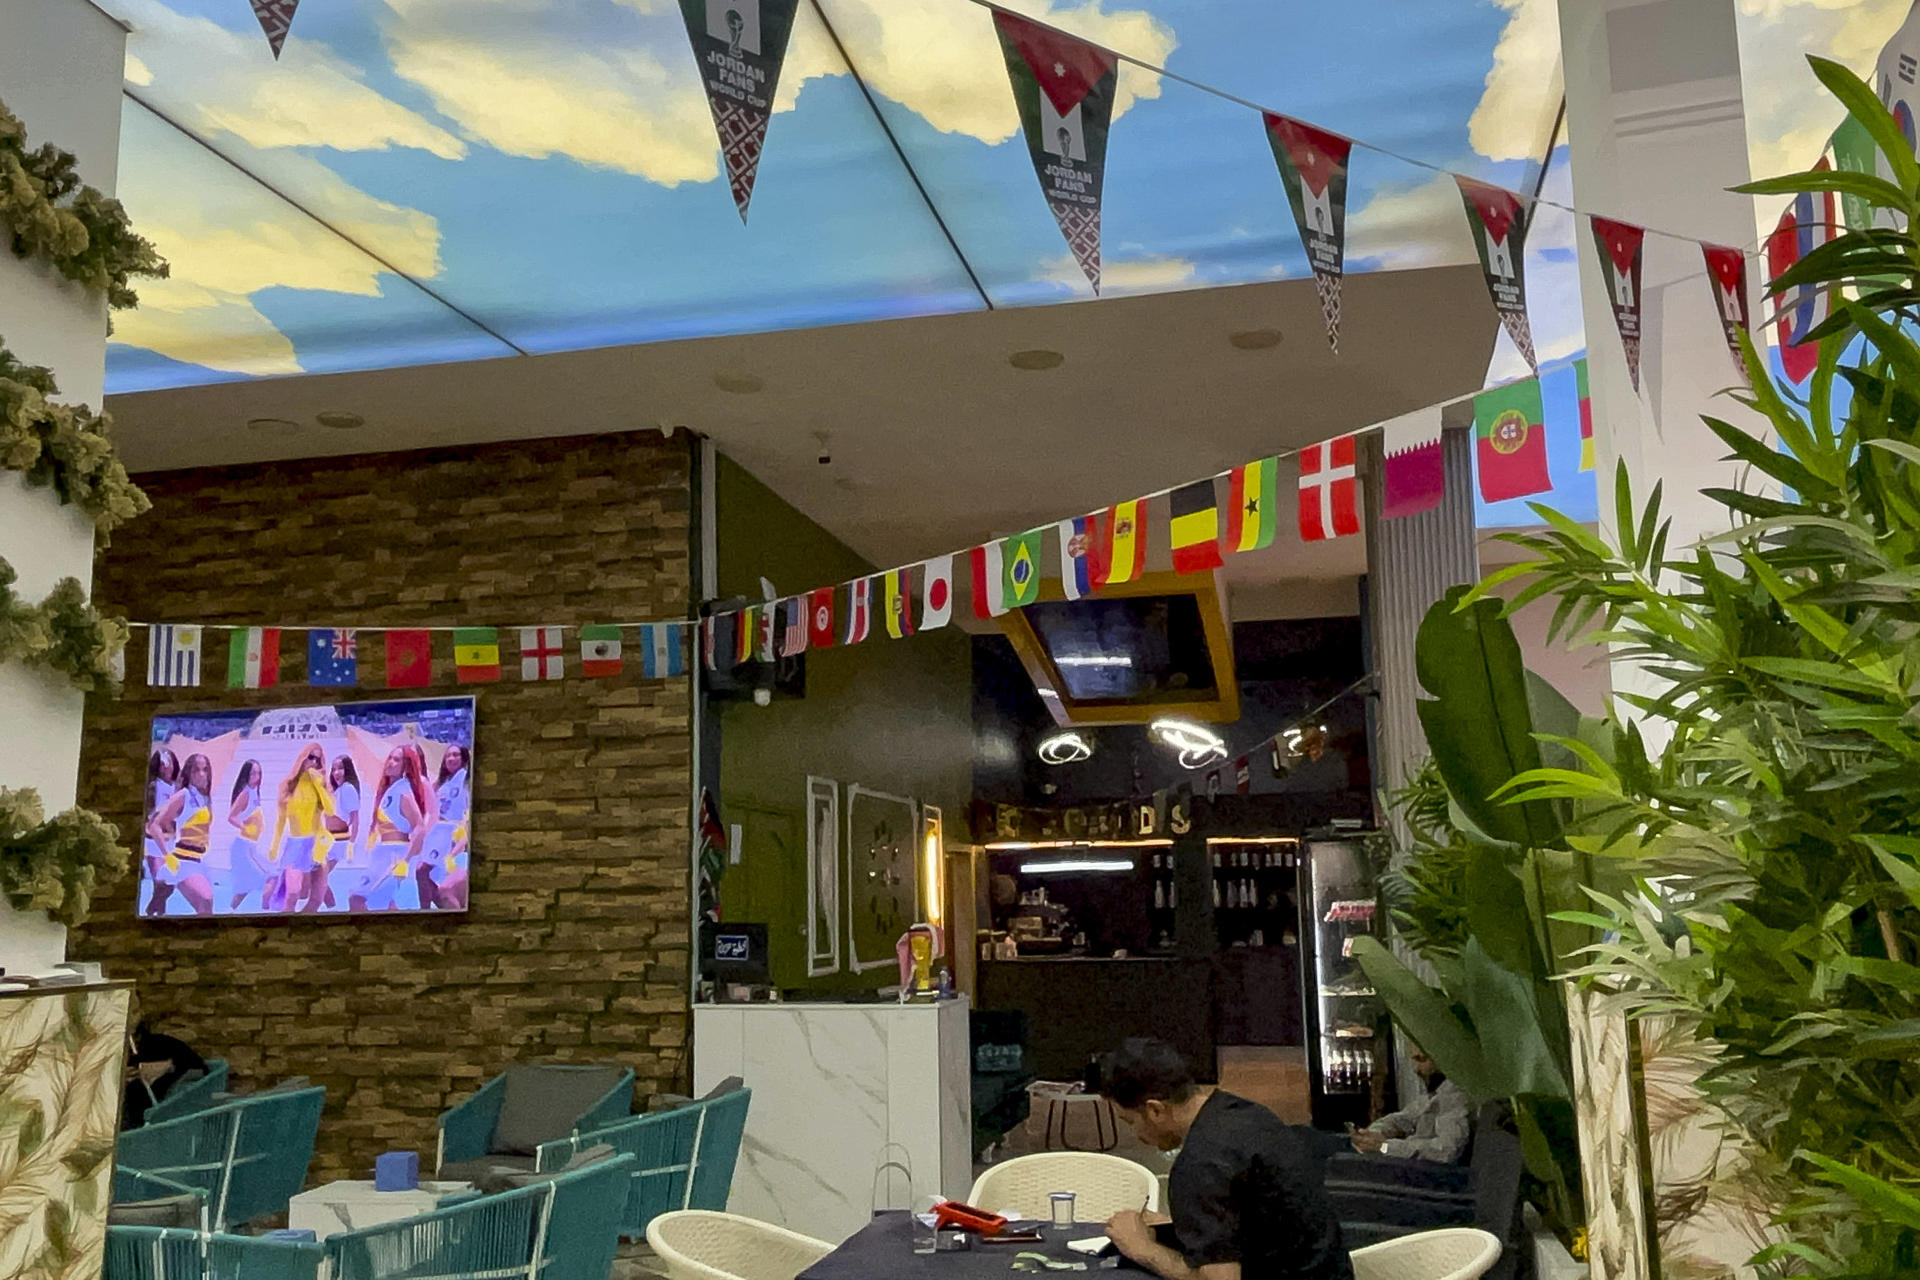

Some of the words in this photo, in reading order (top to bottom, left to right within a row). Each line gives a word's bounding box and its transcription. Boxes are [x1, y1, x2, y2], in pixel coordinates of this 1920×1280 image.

[707, 50, 764, 83] JORDAN
[710, 80, 745, 100] WORLD
[719, 69, 755, 92] FANS
[1044, 164, 1092, 184] JORDAN
